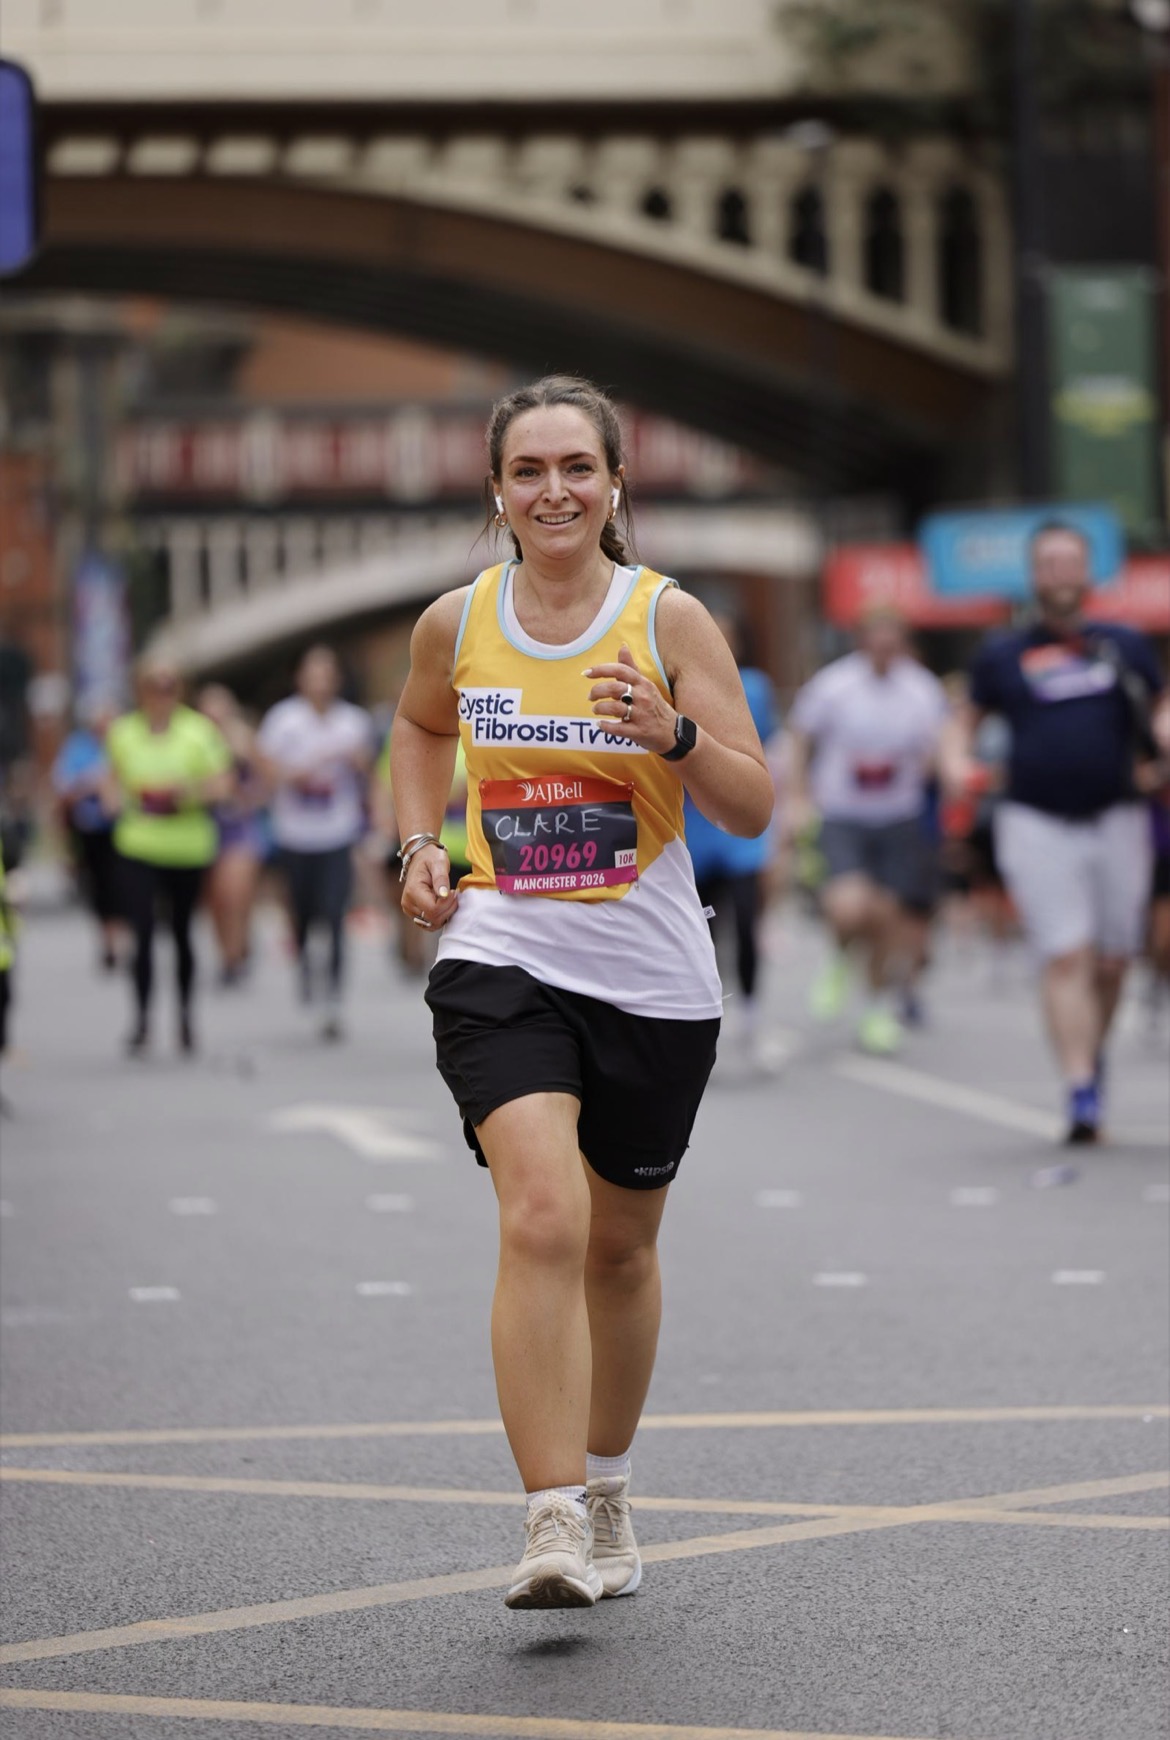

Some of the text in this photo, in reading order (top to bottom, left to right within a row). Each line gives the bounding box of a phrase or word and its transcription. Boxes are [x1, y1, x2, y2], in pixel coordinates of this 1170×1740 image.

[475, 717, 569, 742] Fibrosis
[495, 808, 602, 840] CLARE
[519, 841, 597, 871] 20969
[619, 854, 634, 865] 10K
[513, 872, 605, 891] MANCHESTER 2026
